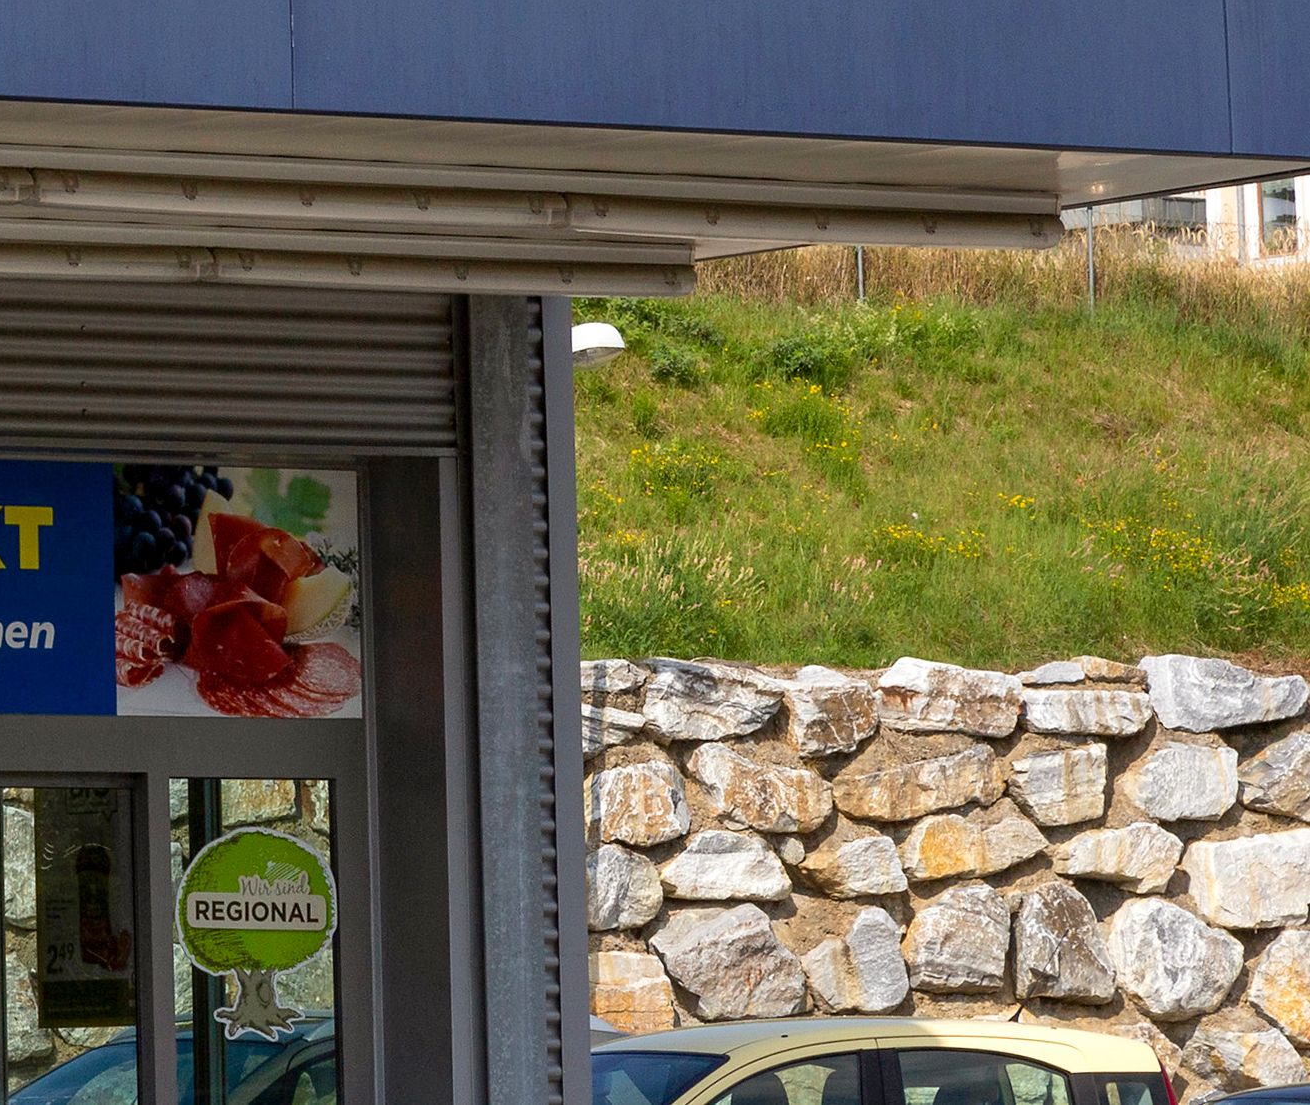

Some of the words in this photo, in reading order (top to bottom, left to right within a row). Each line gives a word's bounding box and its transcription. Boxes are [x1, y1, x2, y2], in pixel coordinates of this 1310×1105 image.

[241, 875, 273, 896] Wir
[275, 872, 309, 896] sind
[195, 900, 319, 923] REGIONAL
